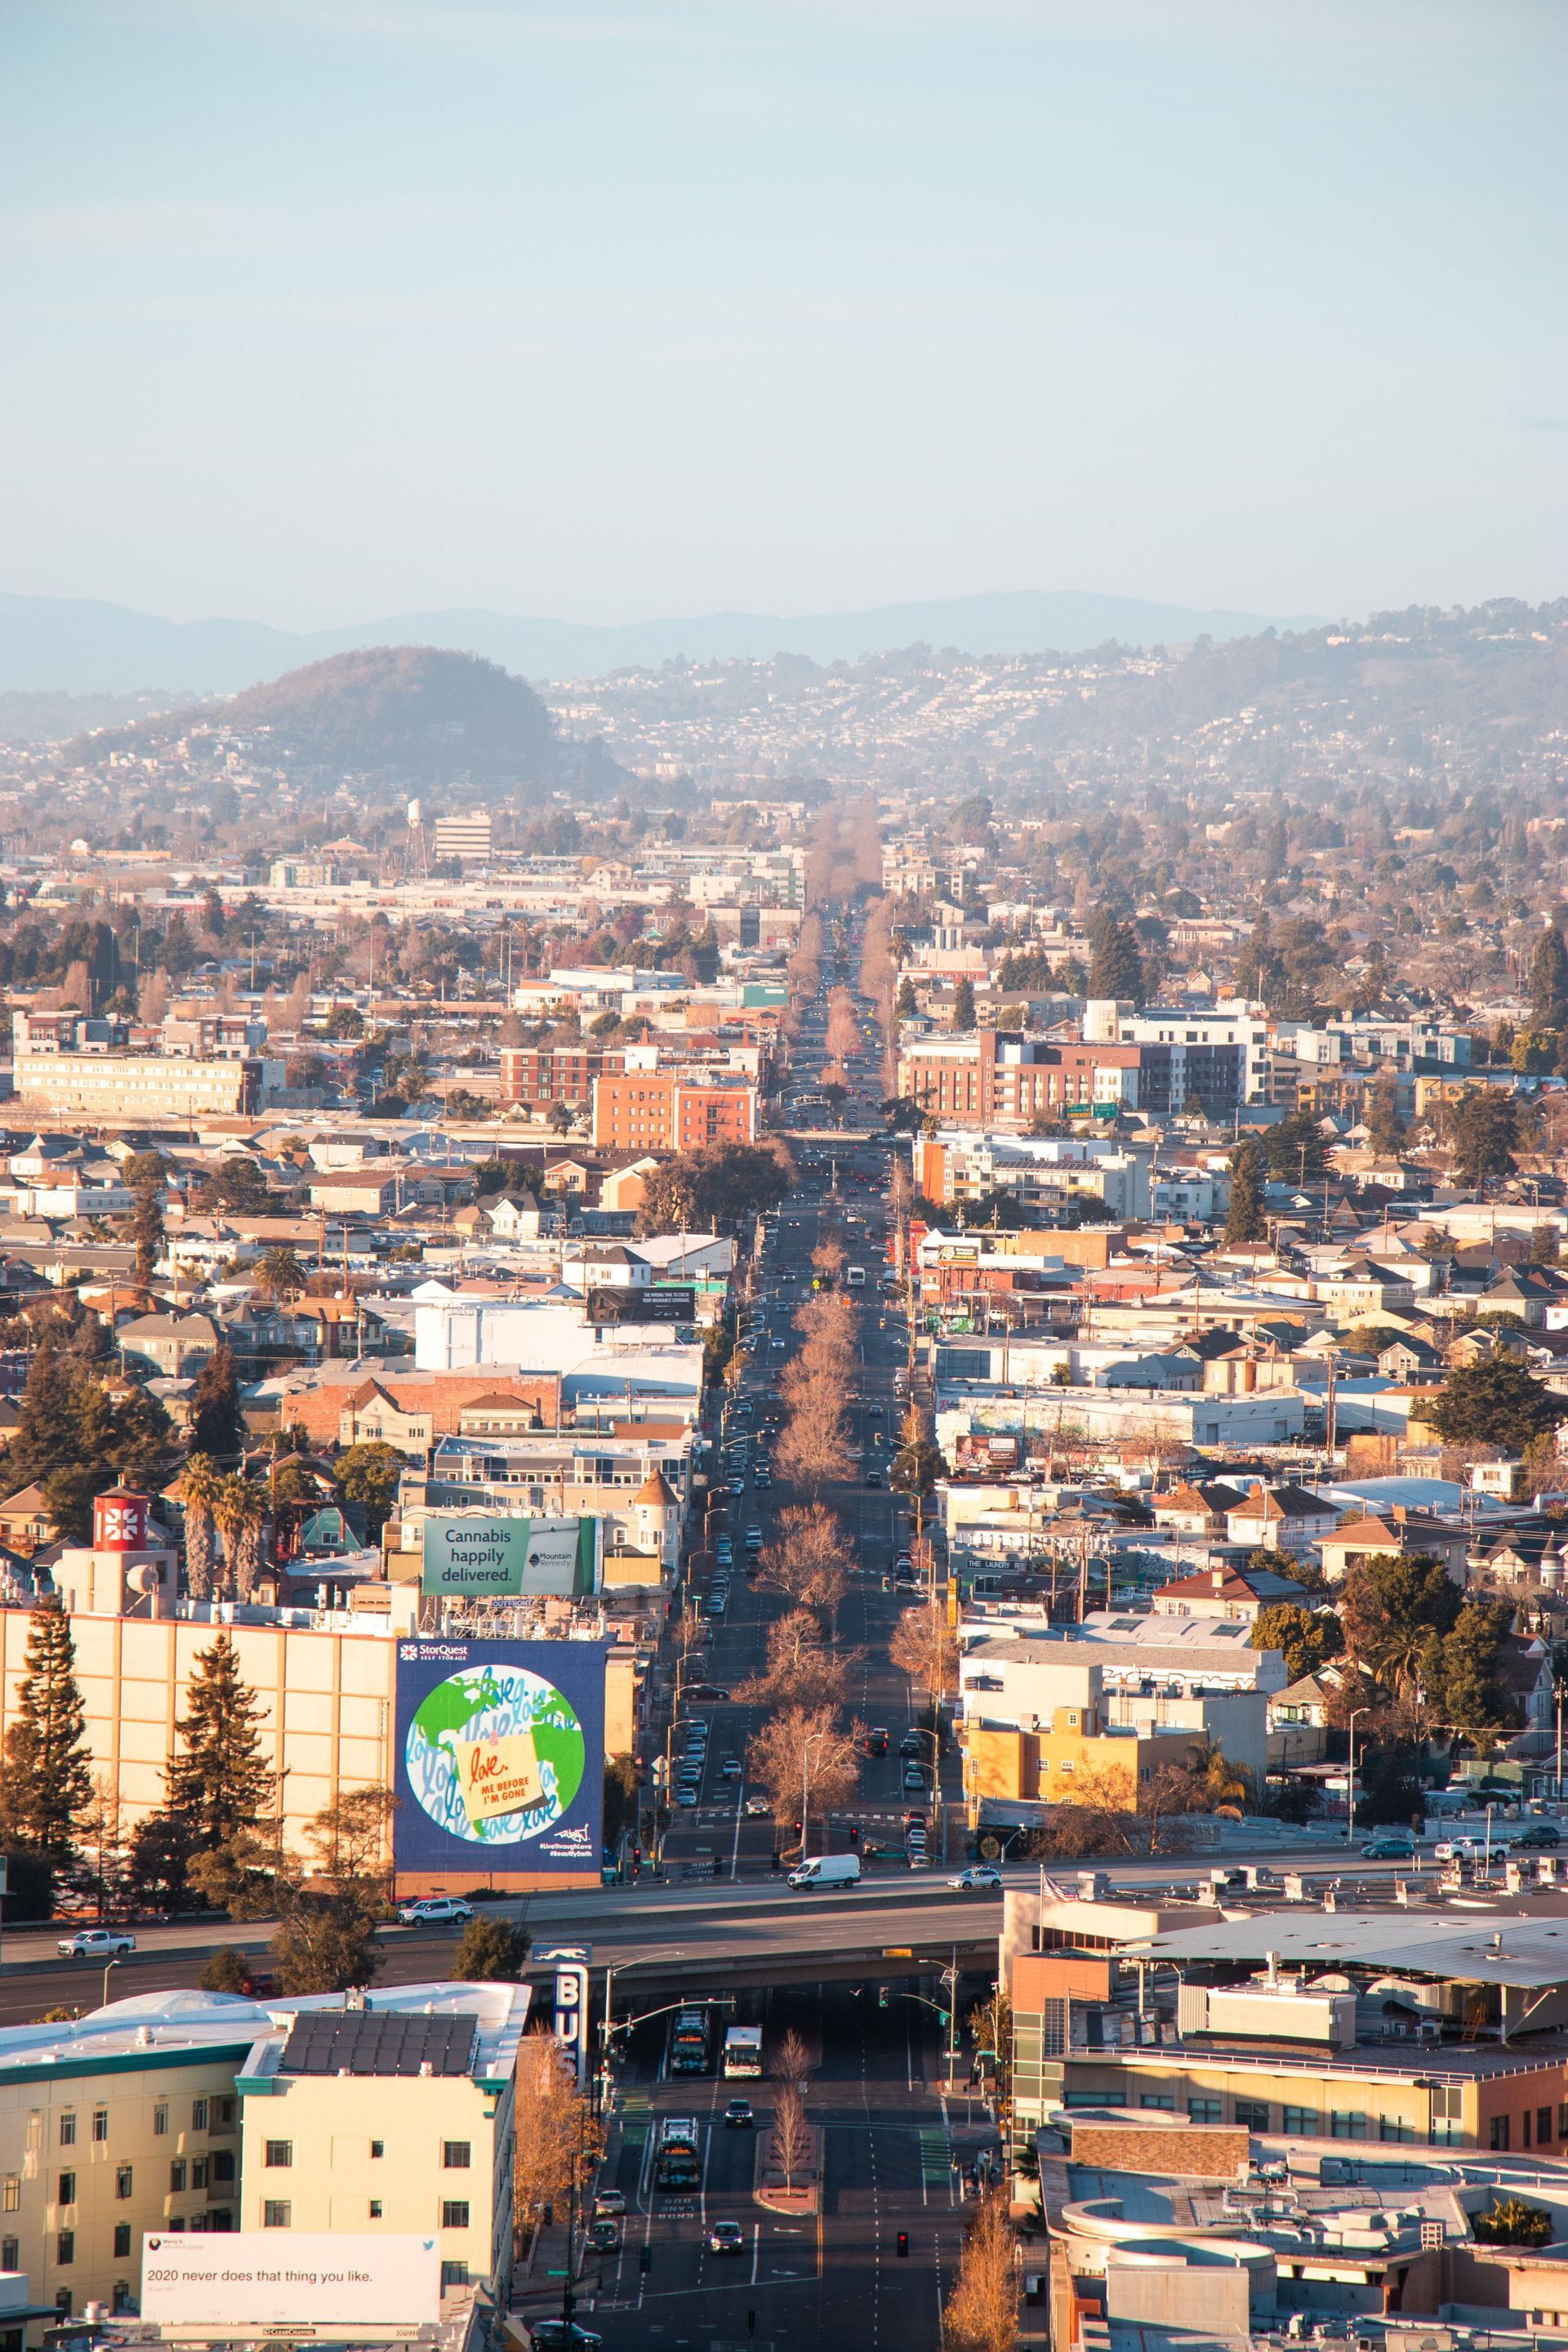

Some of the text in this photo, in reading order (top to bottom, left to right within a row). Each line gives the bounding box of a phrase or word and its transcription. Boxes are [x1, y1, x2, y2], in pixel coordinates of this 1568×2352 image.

[445, 1529, 510, 1543] Cannabis
[451, 1548, 505, 1566] happily
[540, 1560, 571, 1568] Remedy
[442, 1568, 512, 1582] delivered.
[492, 1599, 532, 1607] OUTFRONT
[420, 1645, 468, 1656] StorQuest
[481, 1776, 529, 1795] ME BEFORE
[483, 1788, 525, 1805] I'M GONE
[539, 1842, 592, 1851] #LiveThroughLove
[550, 1850, 592, 1858] #BeautifyEarth
[555, 1974, 579, 2081] BUS
[147, 2270, 373, 2285] 2020 never does that thing you like.
